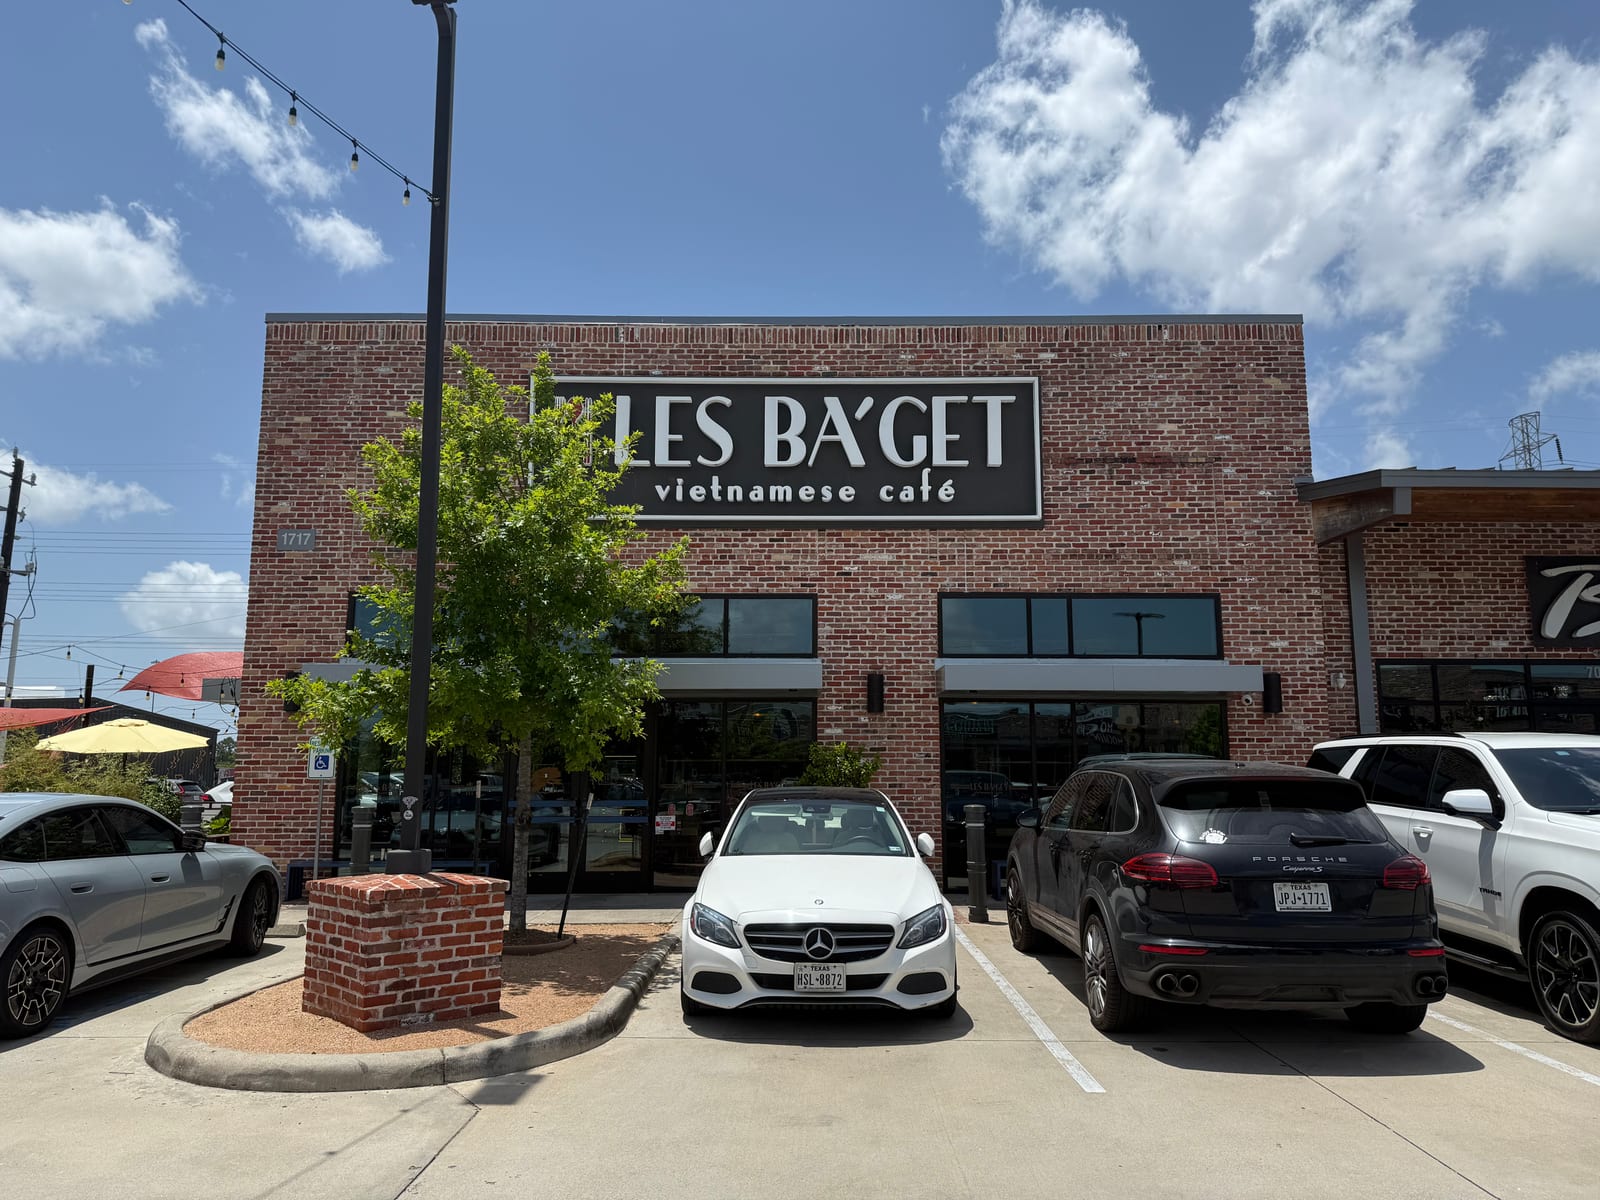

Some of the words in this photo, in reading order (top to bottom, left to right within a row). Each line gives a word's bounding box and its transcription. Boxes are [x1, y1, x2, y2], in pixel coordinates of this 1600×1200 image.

[614, 395, 733, 468] LES
[655, 475, 856, 502] vietnamese
[878, 467, 957, 502] café
[282, 532, 312, 546] 1717
